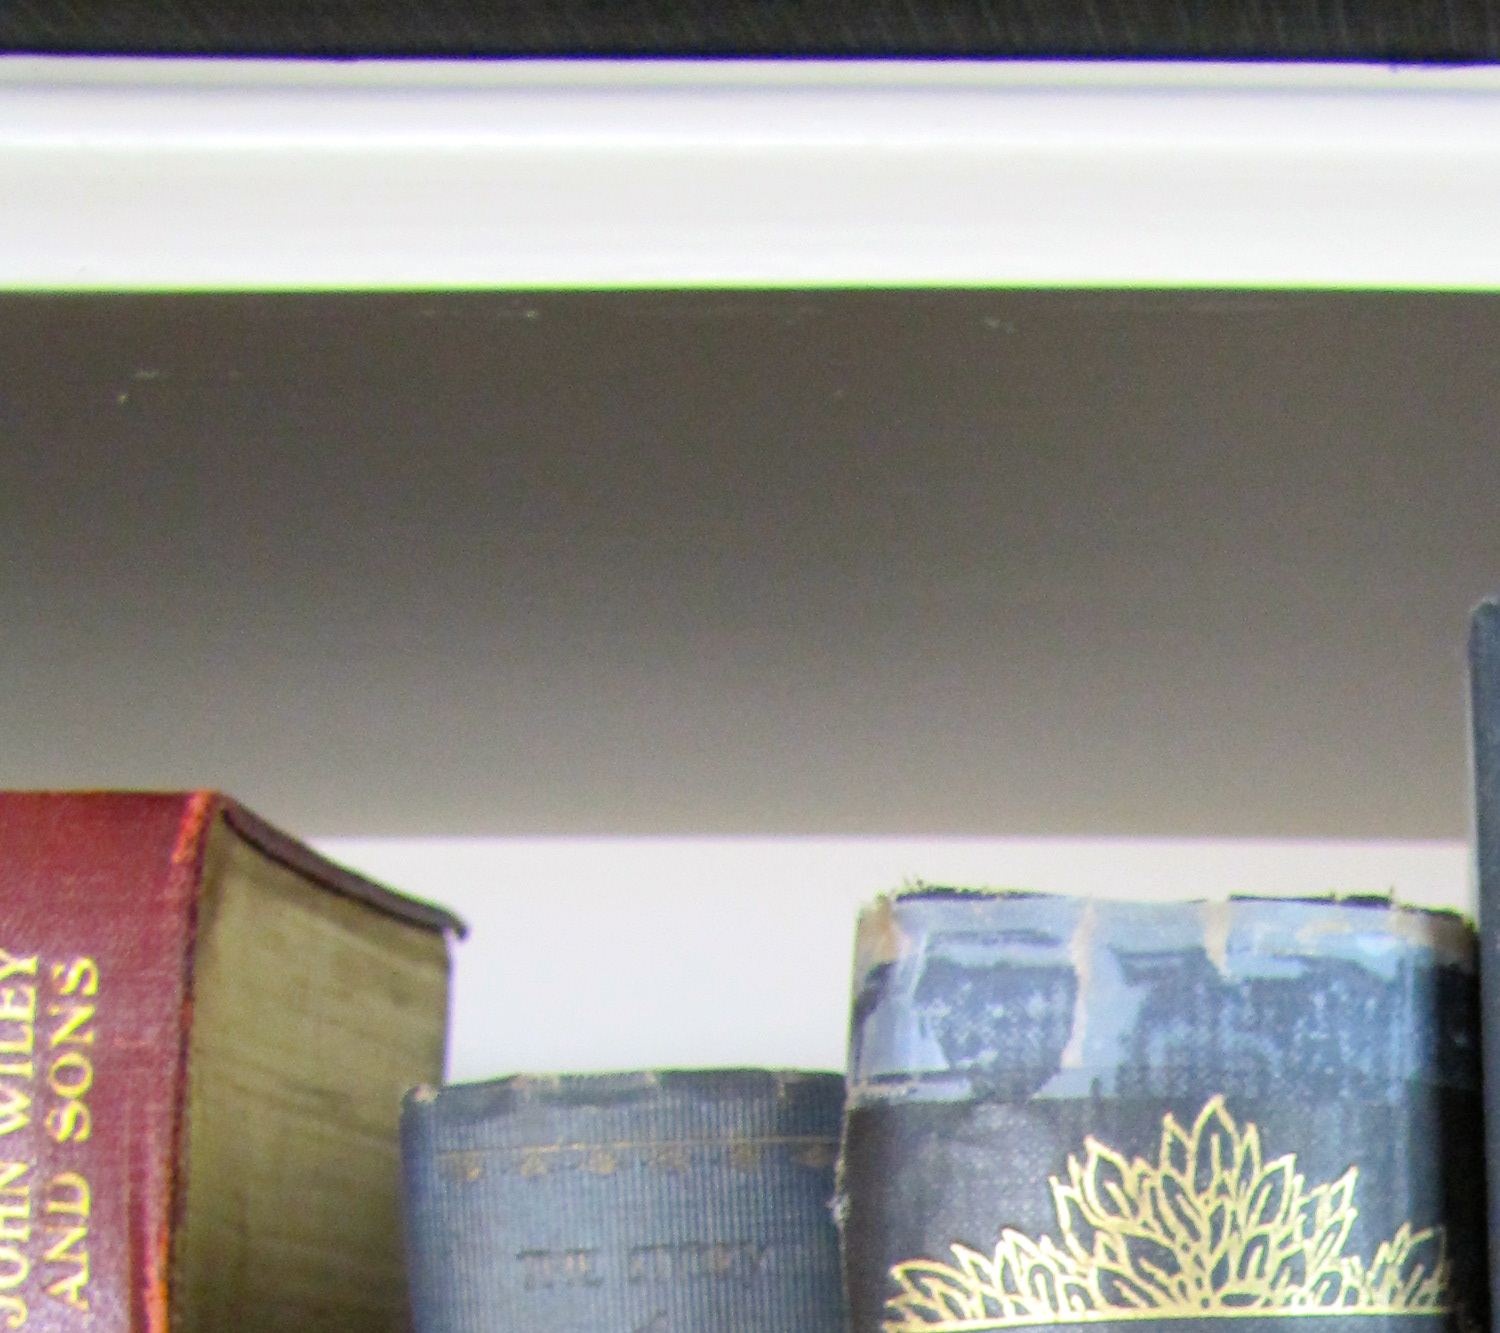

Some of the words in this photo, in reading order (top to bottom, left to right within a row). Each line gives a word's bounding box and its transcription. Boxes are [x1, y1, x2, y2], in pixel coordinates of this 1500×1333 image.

[0, 945, 39, 1137] WILEY
[45, 954, 100, 1145] SONS
[0, 1160, 31, 1330] JOHN
[43, 1170, 92, 1312] AND
